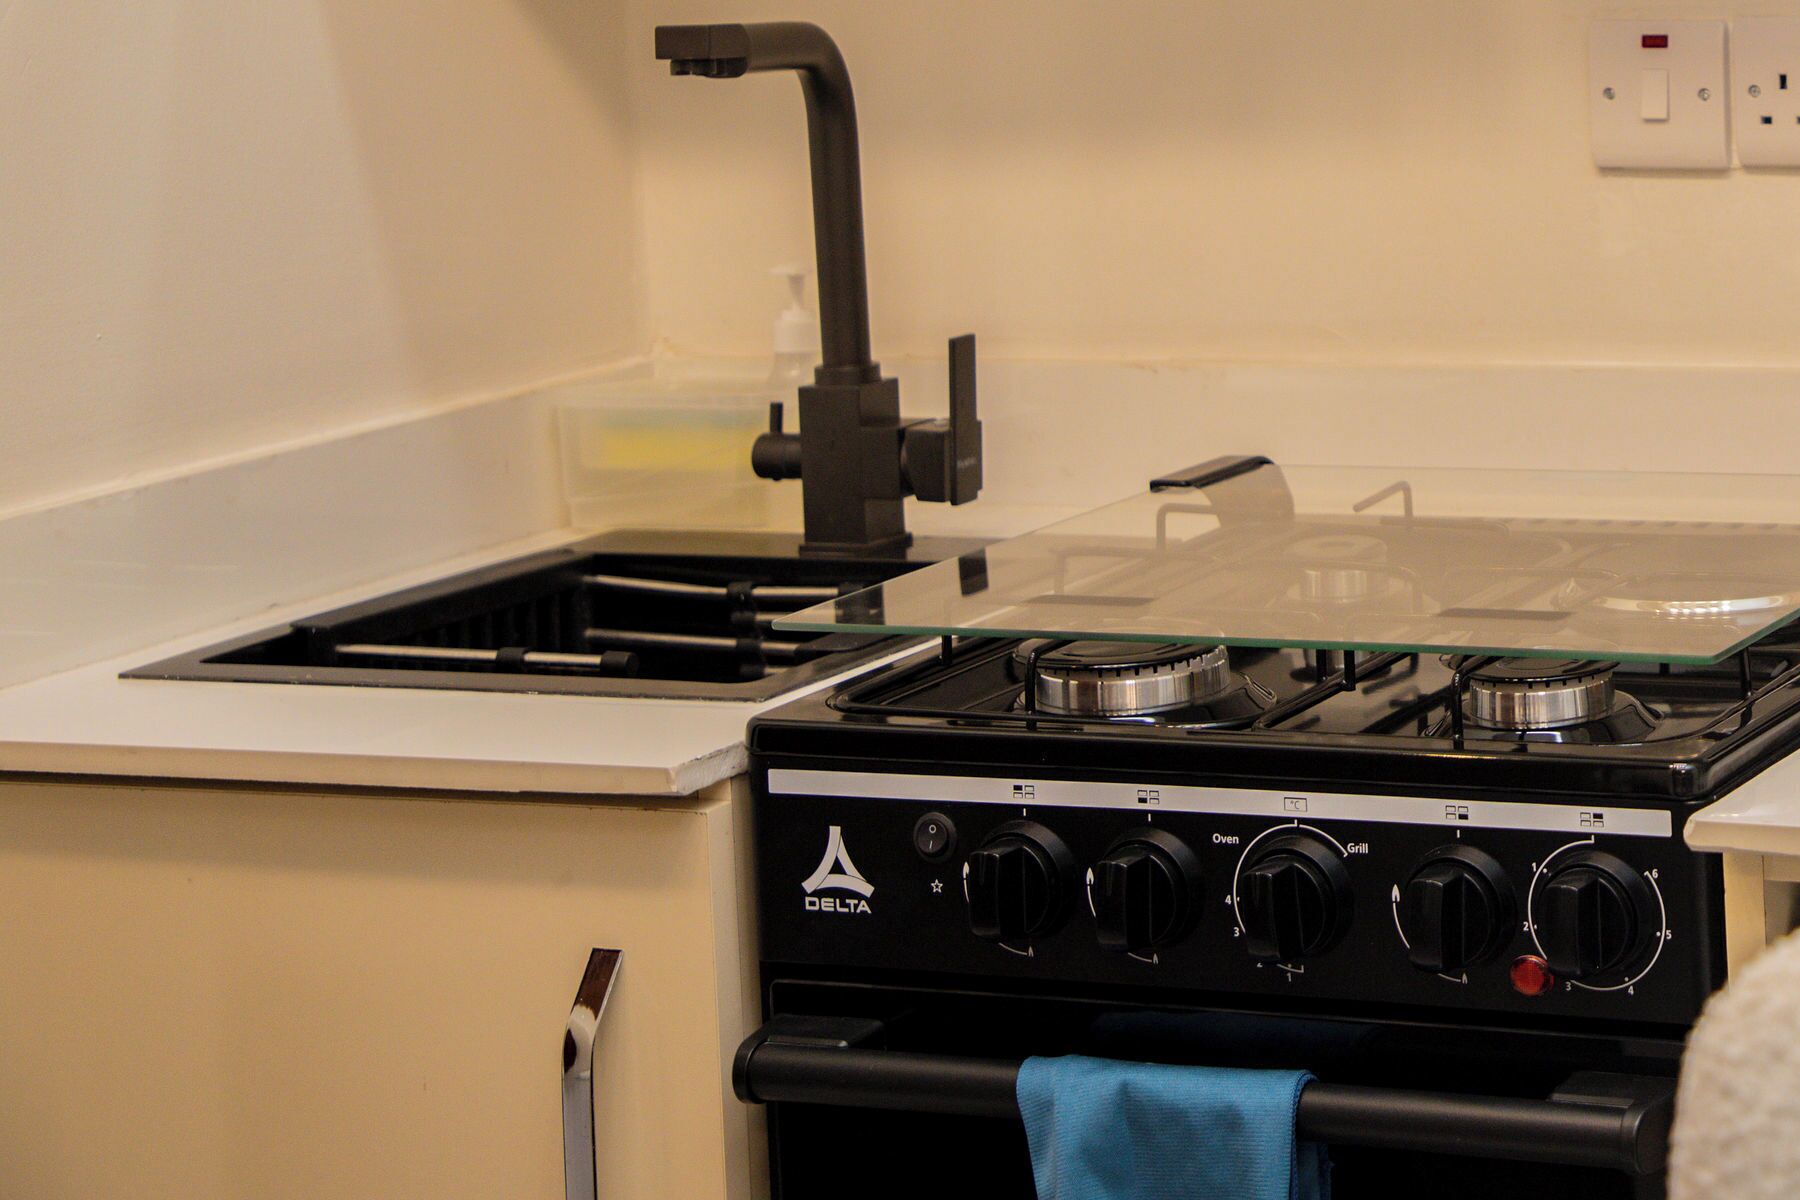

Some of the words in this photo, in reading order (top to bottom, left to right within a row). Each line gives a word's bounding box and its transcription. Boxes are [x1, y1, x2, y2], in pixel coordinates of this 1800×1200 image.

[1212, 833, 1239, 844] Oven
[1347, 842, 1369, 854] Grill
[1531, 862, 1537, 873] 1
[1651, 868, 1658, 879] 6
[804, 896, 872, 914] DELTA
[1225, 895, 1232, 905] 4
[1523, 922, 1529, 931] 2
[1233, 927, 1240, 937] 3
[1665, 930, 1672, 940] 5
[1286, 972, 1292, 982] 1
[1565, 981, 1572, 991] 3
[1627, 985, 1634, 995] 4
